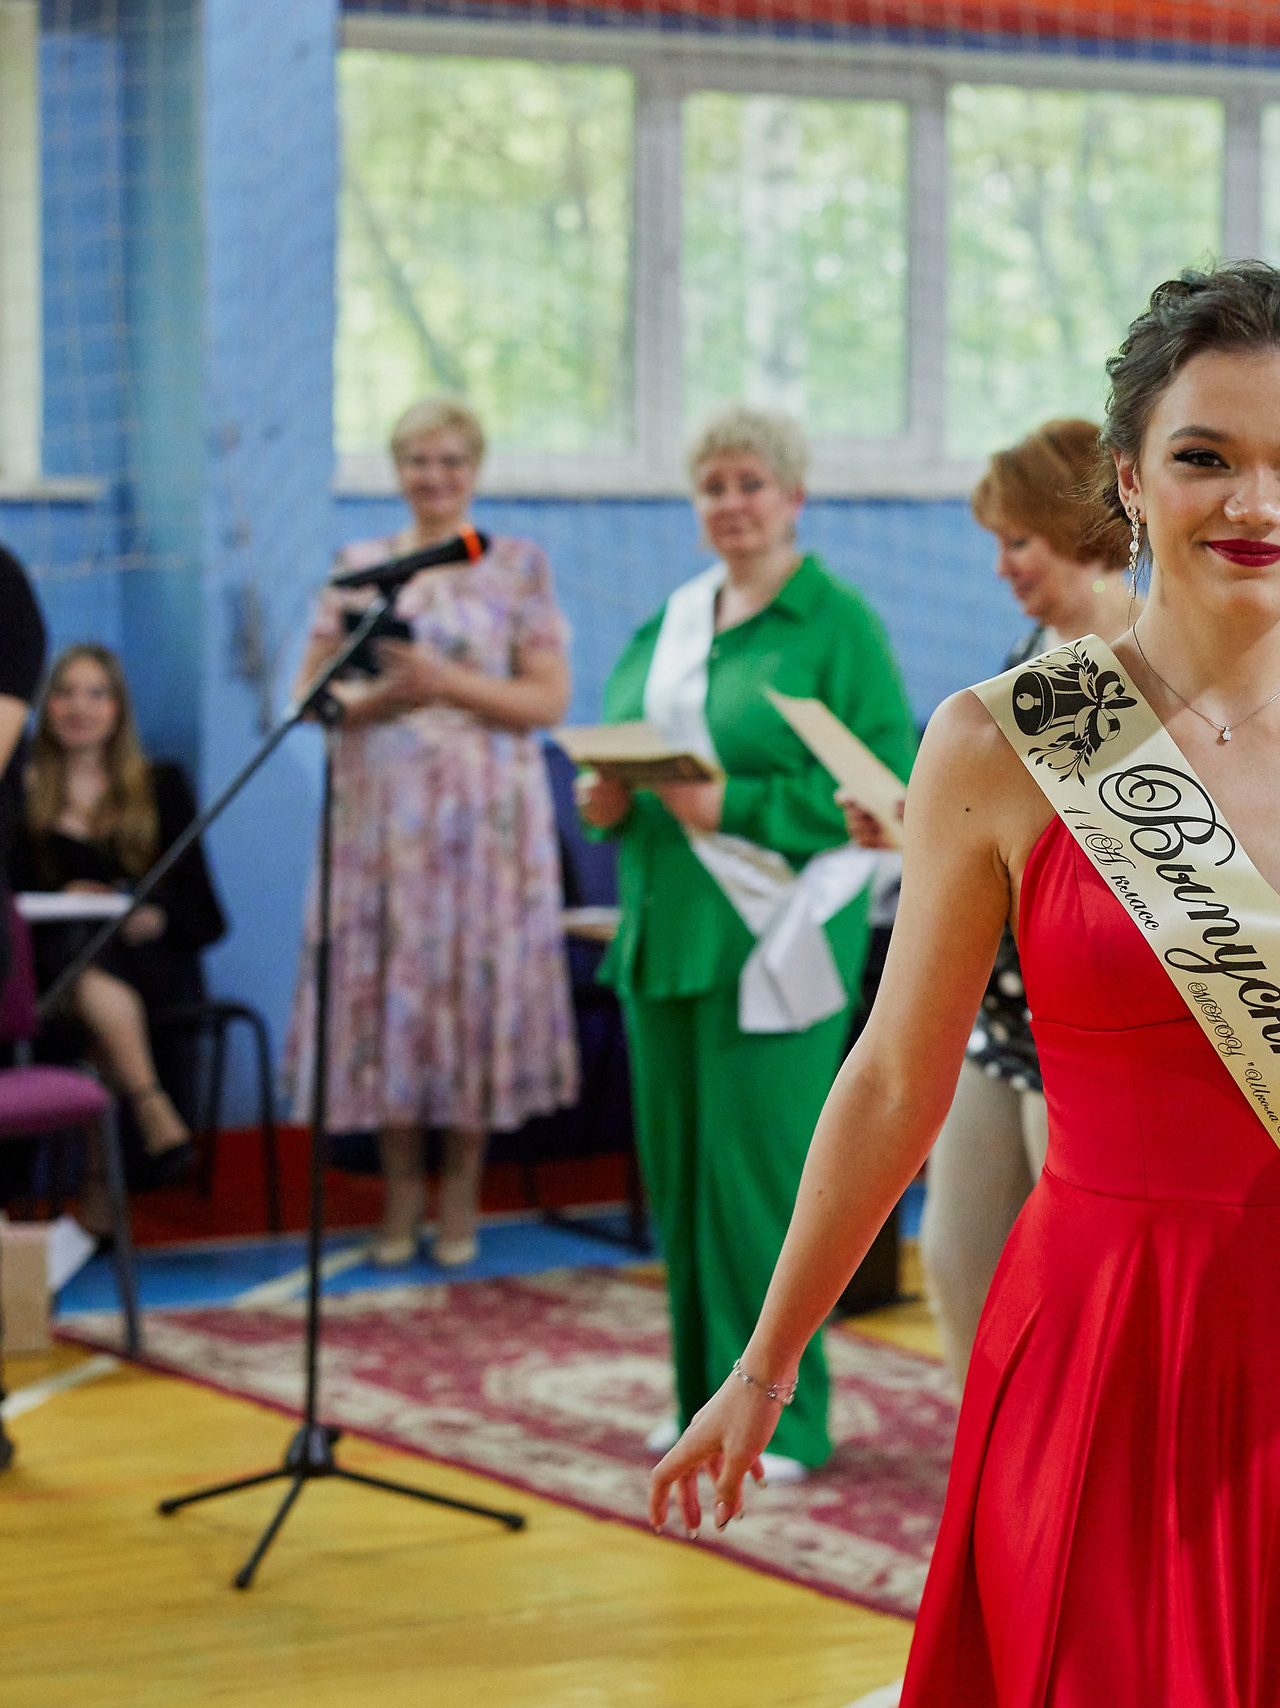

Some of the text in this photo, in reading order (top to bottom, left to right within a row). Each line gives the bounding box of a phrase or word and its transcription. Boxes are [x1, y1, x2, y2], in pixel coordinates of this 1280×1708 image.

[1111, 875, 1160, 931] класс
[1187, 982, 1246, 1057] МАОУ
[1244, 1061, 1280, 1124] "Школа
